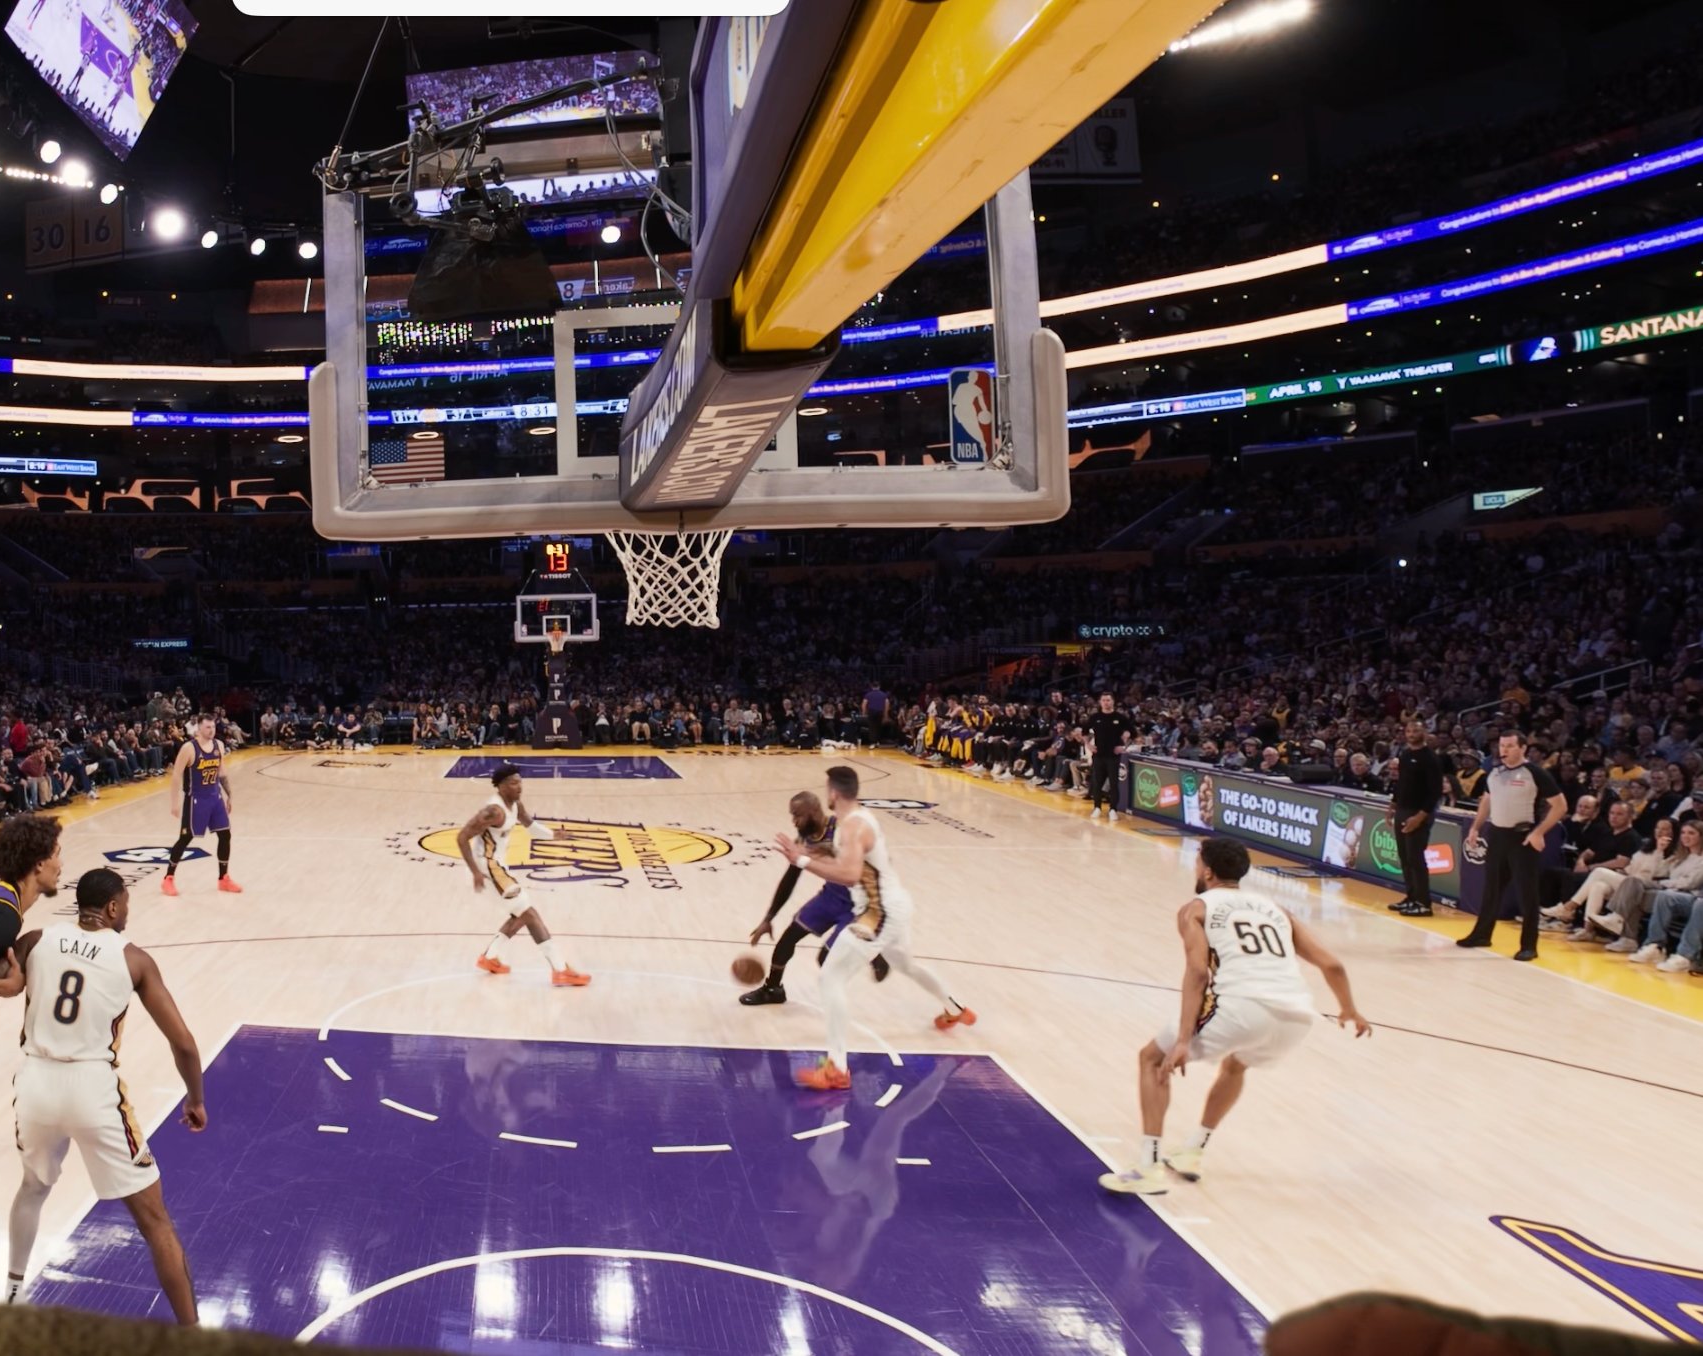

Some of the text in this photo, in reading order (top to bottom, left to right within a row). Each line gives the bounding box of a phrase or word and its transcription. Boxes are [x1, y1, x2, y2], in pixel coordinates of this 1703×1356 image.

[32, 223, 65, 252] 30
[84, 215, 110, 244] 16
[630, 306, 697, 487] LAKERS.COM
[1269, 382, 1305, 399] APRIL
[1307, 380, 1322, 393] 16
[1402, 362, 1453, 377] THEATER
[520, 405, 549, 417] 8:31
[653, 394, 795, 503] LAKERS.COM
[957, 442, 979, 460] NBA
[546, 543, 569, 556] 8:31
[550, 553, 568, 571] 13
[202, 769, 217, 785] 77
[1219, 788, 1319, 827] THE GO-TO SNACK
[1223, 809, 1312, 847] OF LAKERS FANS
[625, 832, 683, 891] LOS ANGELES
[58, 936, 103, 961] CAIN
[1233, 921, 1286, 958] 50
[53, 969, 84, 1025] 8
